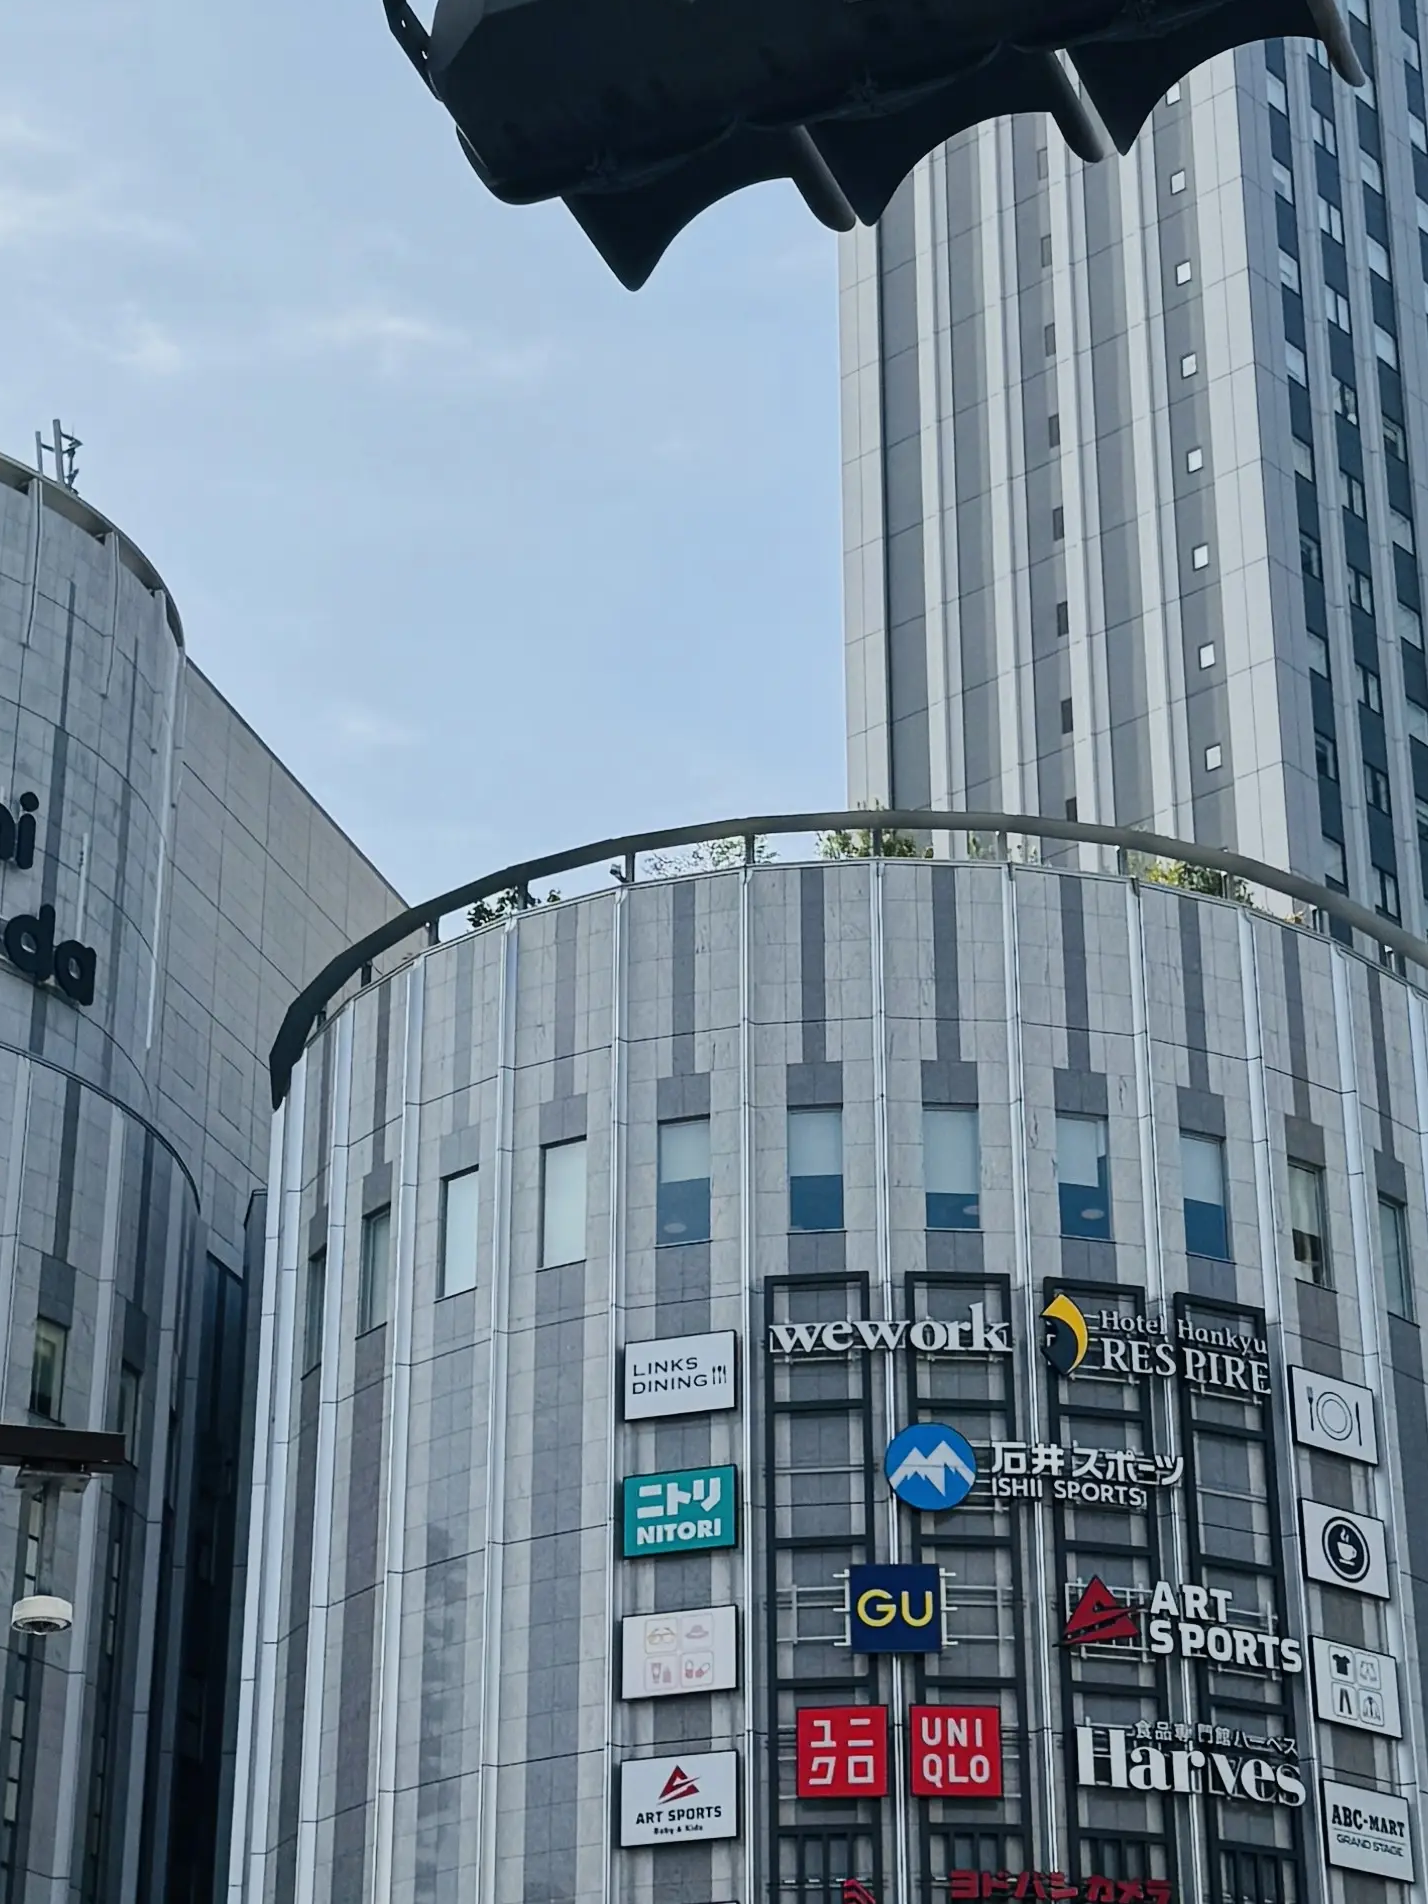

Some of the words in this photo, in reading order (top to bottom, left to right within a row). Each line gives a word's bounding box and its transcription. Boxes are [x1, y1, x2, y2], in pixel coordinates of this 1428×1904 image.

[770, 1302, 1013, 1354] wework
[1100, 1309, 1168, 1336] Hotel
[1176, 1318, 1267, 1357] Hankyu
[633, 1356, 699, 1378] LINKS
[1100, 1337, 1272, 1395] RESPIRE
[632, 1373, 709, 1395] DINING
[991, 1440, 1185, 1487] 石井スポーツ
[636, 1476, 723, 1520] ニトリ
[991, 1477, 1043, 1498] ISHII
[1053, 1479, 1143, 1507] SPORTS
[636, 1518, 723, 1546] NITORI
[856, 1588, 935, 1628] GU
[1149, 1580, 1233, 1624] ART
[1149, 1618, 1303, 1674] SPORTS
[810, 1718, 876, 1749] ユニ
[920, 1716, 985, 1748] UNI
[809, 1755, 876, 1786] クロ
[921, 1753, 991, 1789] QLO
[1076, 1725, 1307, 1808] Harves
[635, 1810, 664, 1825] ART
[667, 1805, 723, 1822] SPORTS
[1331, 1803, 1405, 1838] ABC-MART
[1336, 1833, 1372, 1850] GRAND
